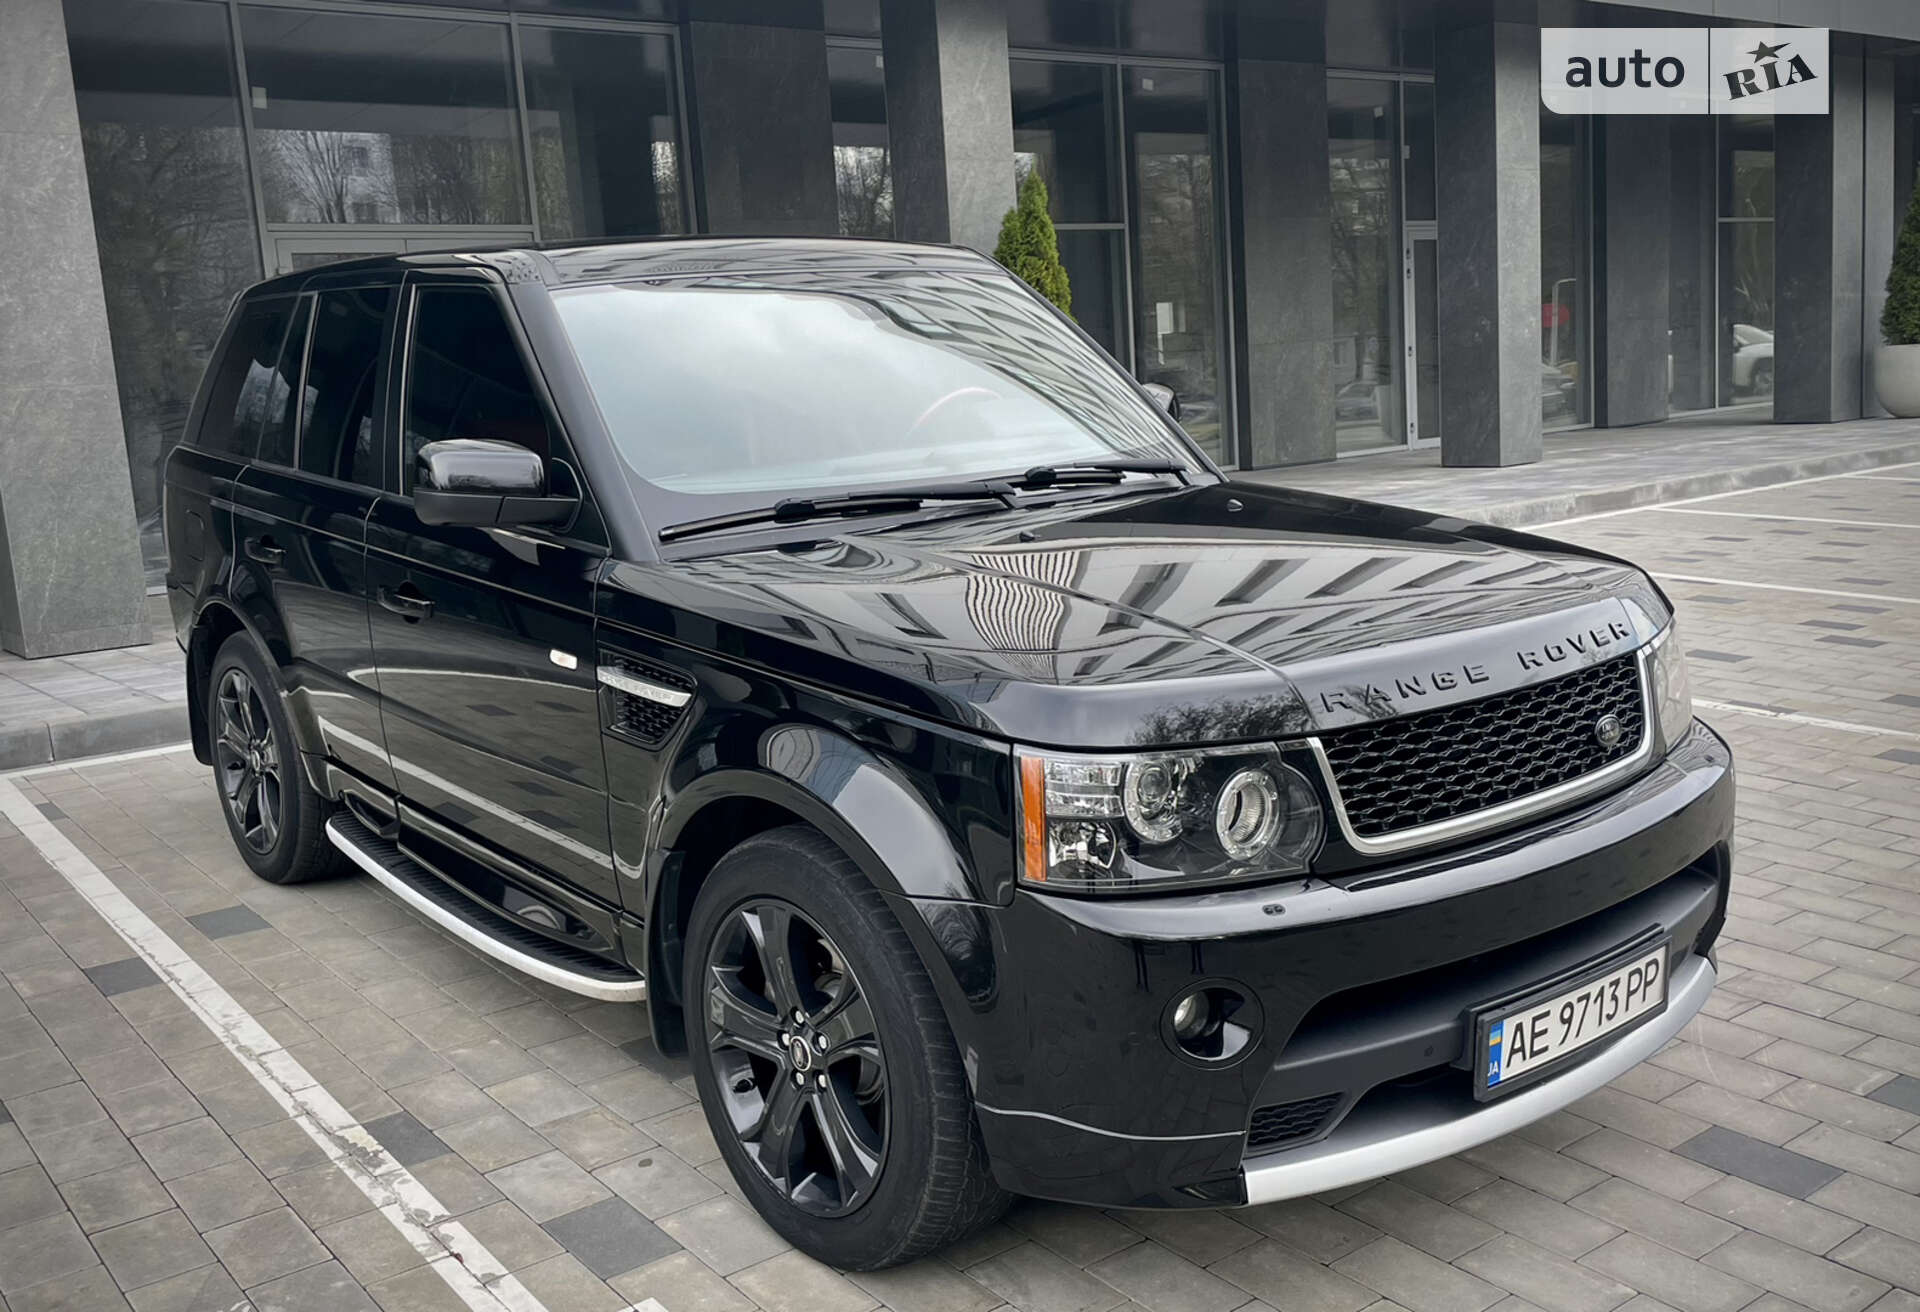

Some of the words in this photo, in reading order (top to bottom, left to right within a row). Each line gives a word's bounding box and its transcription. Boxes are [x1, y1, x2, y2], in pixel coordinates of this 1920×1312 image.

[1320, 664, 1489, 712] RANGE
[1517, 622, 1630, 670] ROVER
[1506, 1010, 1550, 1068] AE
[1559, 977, 1621, 1045] 9713
[1625, 957, 1659, 1012] PP
